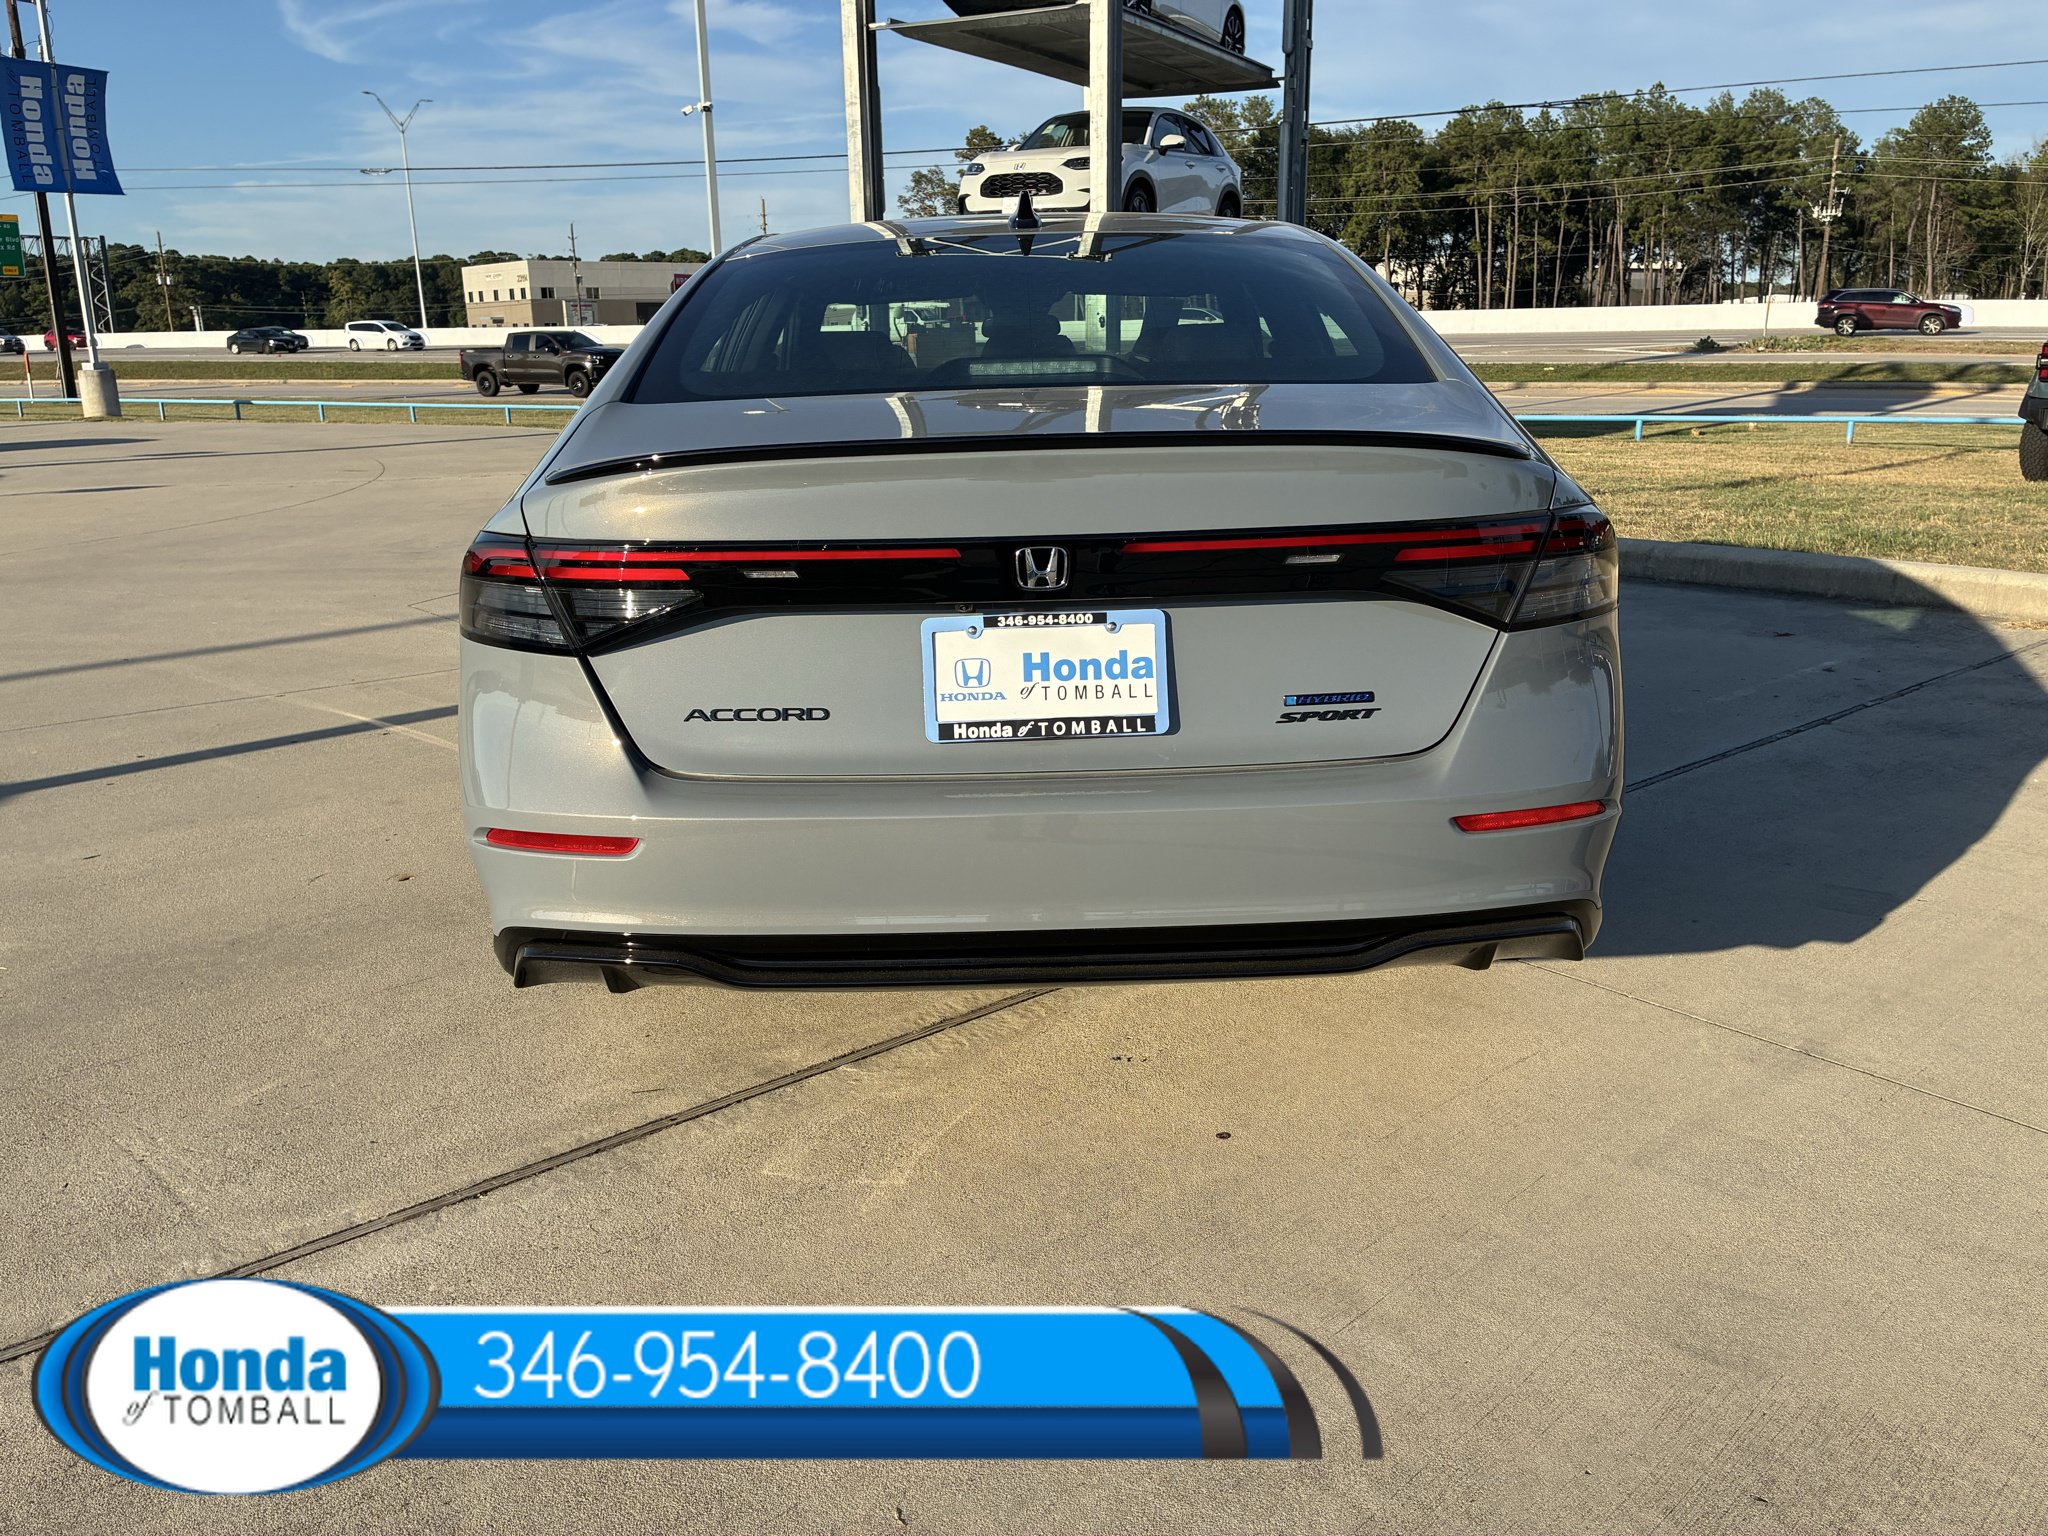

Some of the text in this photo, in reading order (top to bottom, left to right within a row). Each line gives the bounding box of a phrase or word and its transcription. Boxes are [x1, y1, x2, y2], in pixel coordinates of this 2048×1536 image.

[20, 75, 53, 185] Honda
[64, 73, 97, 180] Honda
[86, 78, 104, 167] TOMBALL
[8, 90, 34, 183] TOMBALL
[997, 613, 1093, 627] 346-954-8400
[1022, 650, 1154, 682] Honda
[940, 691, 1007, 702] HONDA
[1020, 682, 1153, 701] of TOMBALL
[1297, 693, 1370, 705] HYBRID
[683, 707, 831, 722] ACCORD
[1275, 708, 1382, 724] SPORT
[953, 718, 1146, 739] Honda of TOMBALL
